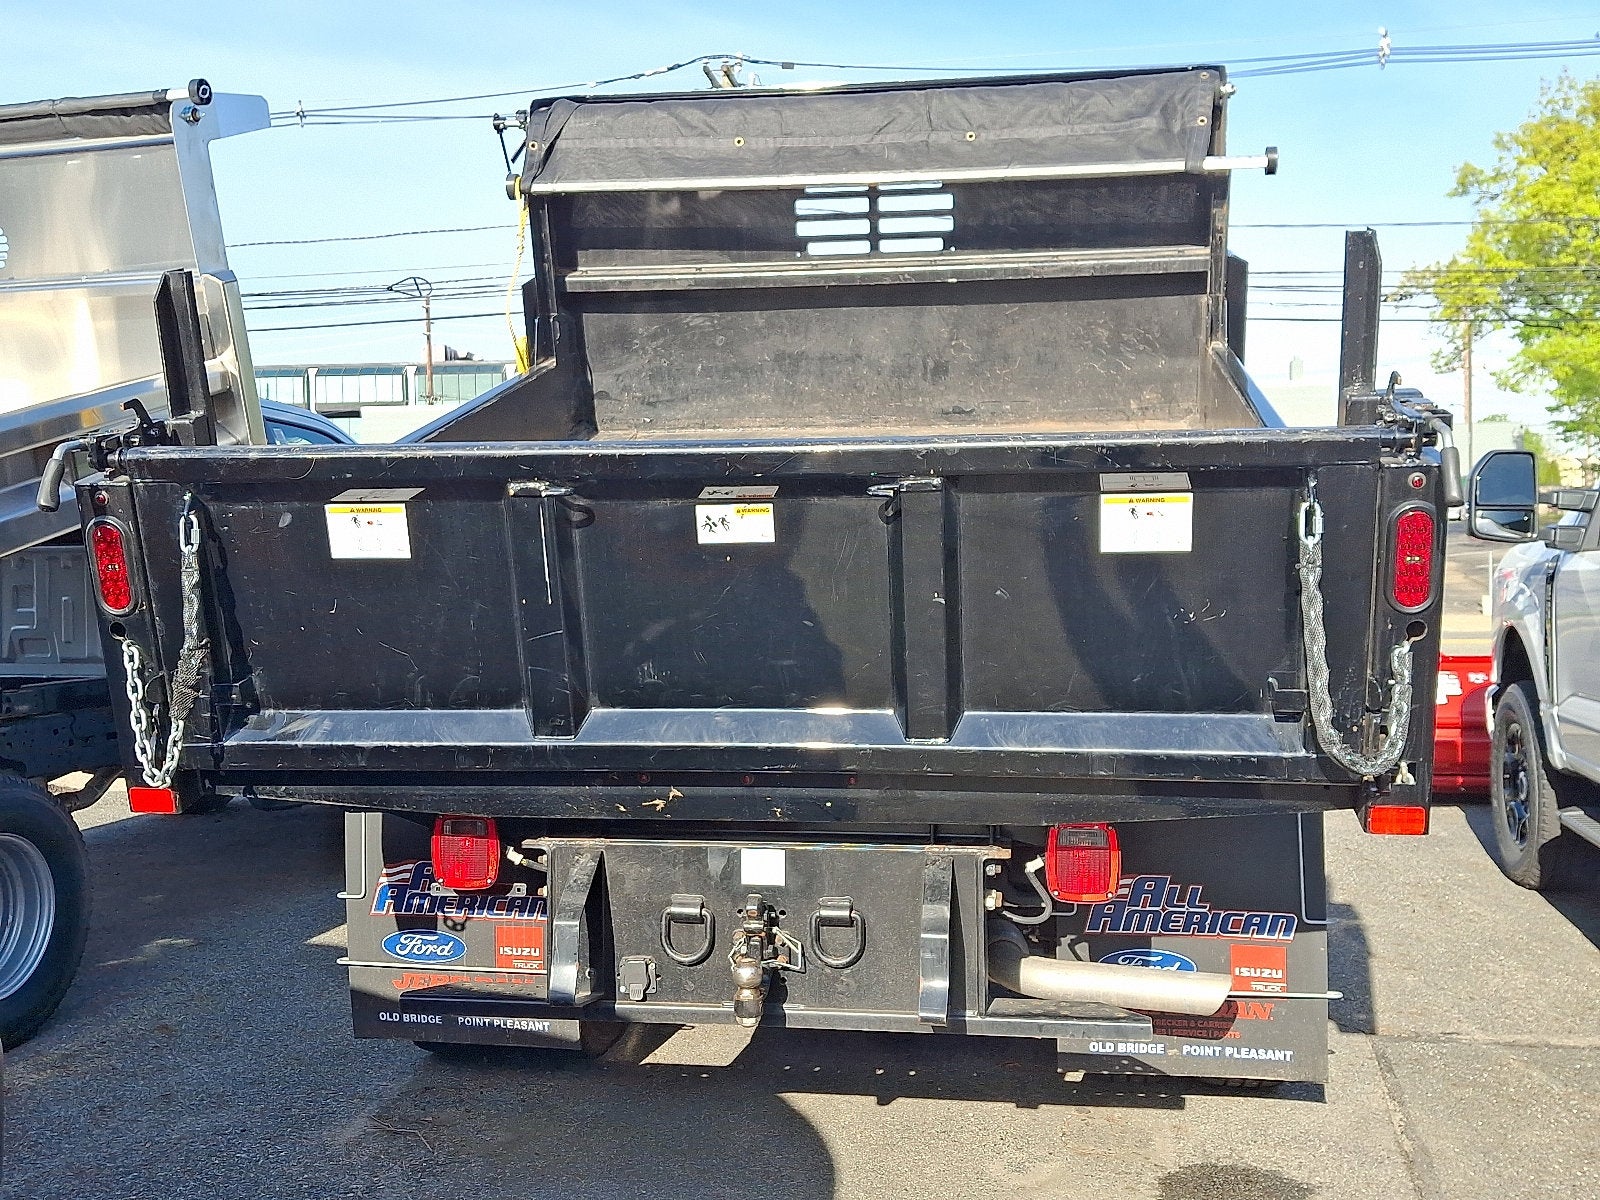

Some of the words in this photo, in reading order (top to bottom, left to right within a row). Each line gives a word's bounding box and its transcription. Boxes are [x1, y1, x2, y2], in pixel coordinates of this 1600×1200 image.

[395, 933, 455, 957] Ford
[499, 947, 540, 957] ISUZU
[513, 961, 540, 970] TRUCK
[1234, 966, 1283, 979] ISUZU
[1251, 984, 1283, 993] TRUCK
[379, 1012, 399, 1022] OLD
[403, 1013, 442, 1025] BRIDGE
[457, 1016, 491, 1028] POINT
[493, 1019, 550, 1032] PLEASANT
[1153, 1019, 1188, 1027] RECKER
[1172, 1029, 1208, 1037] SERVICE
[1213, 1031, 1241, 1039] PARTS
[1089, 1042, 1115, 1054] OLD
[1117, 1043, 1165, 1055] BRIDGE
[1182, 1044, 1222, 1057] POINT
[1225, 1047, 1294, 1061] PLEASANT
